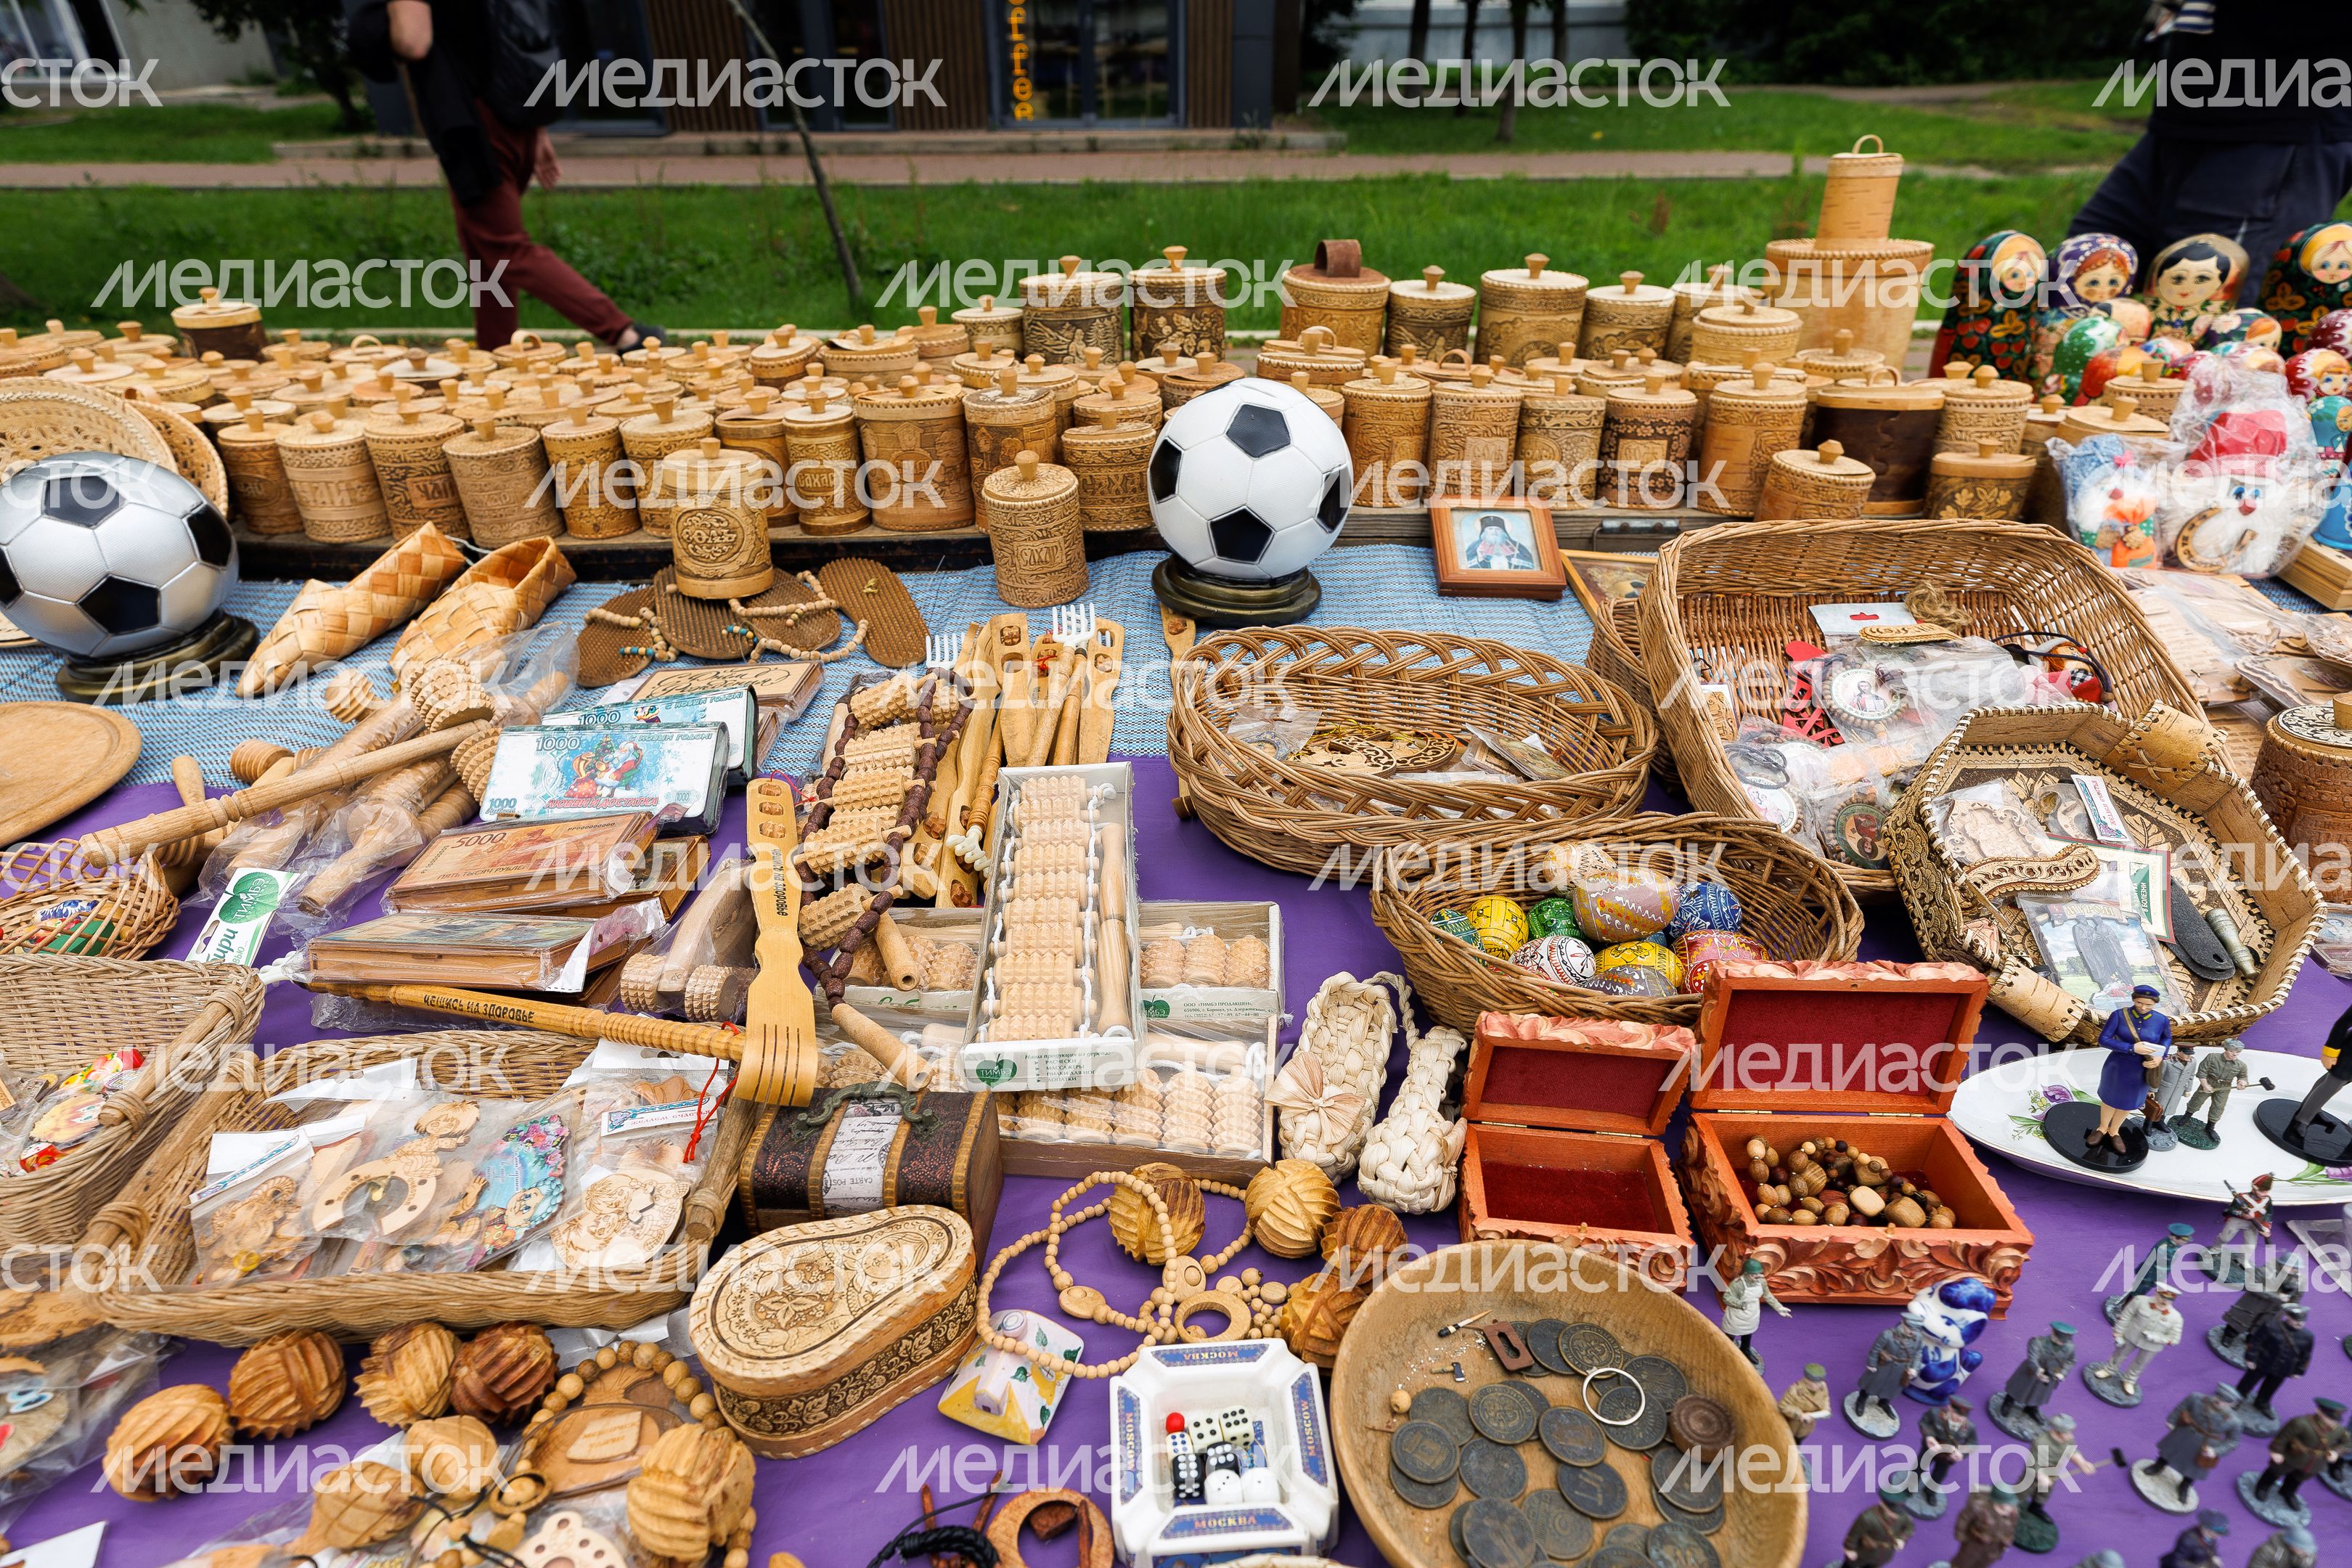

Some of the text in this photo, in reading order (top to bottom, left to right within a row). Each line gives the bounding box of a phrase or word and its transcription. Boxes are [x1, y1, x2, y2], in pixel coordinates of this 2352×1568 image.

[579, 710, 621, 724] 1000
[536, 736, 581, 751] 1000
[489, 798, 517, 809] 1000
[544, 798, 589, 809] ЛЮБВИ
[598, 796, 658, 809] ДОСТАТКА
[676, 792, 690, 801] 1000
[451, 832, 507, 850] 5000
[462, 870, 490, 878] ТЫСЯЧ
[233, 878, 266, 920] ТИМБЭ
[774, 883, 788, 916] здоровье
[467, 1001, 480, 1013] НА
[483, 1003, 535, 1024] ЗДОРОВЬЕ
[980, 1068, 1011, 1077] ТИМБЭ
[1183, 1350, 1239, 1360] МОСКВА
[1301, 1400, 1316, 1456] MOSCOW
[1125, 1413, 1137, 1471] MOSCOW
[1193, 1516, 1258, 1530] МОСКВА
